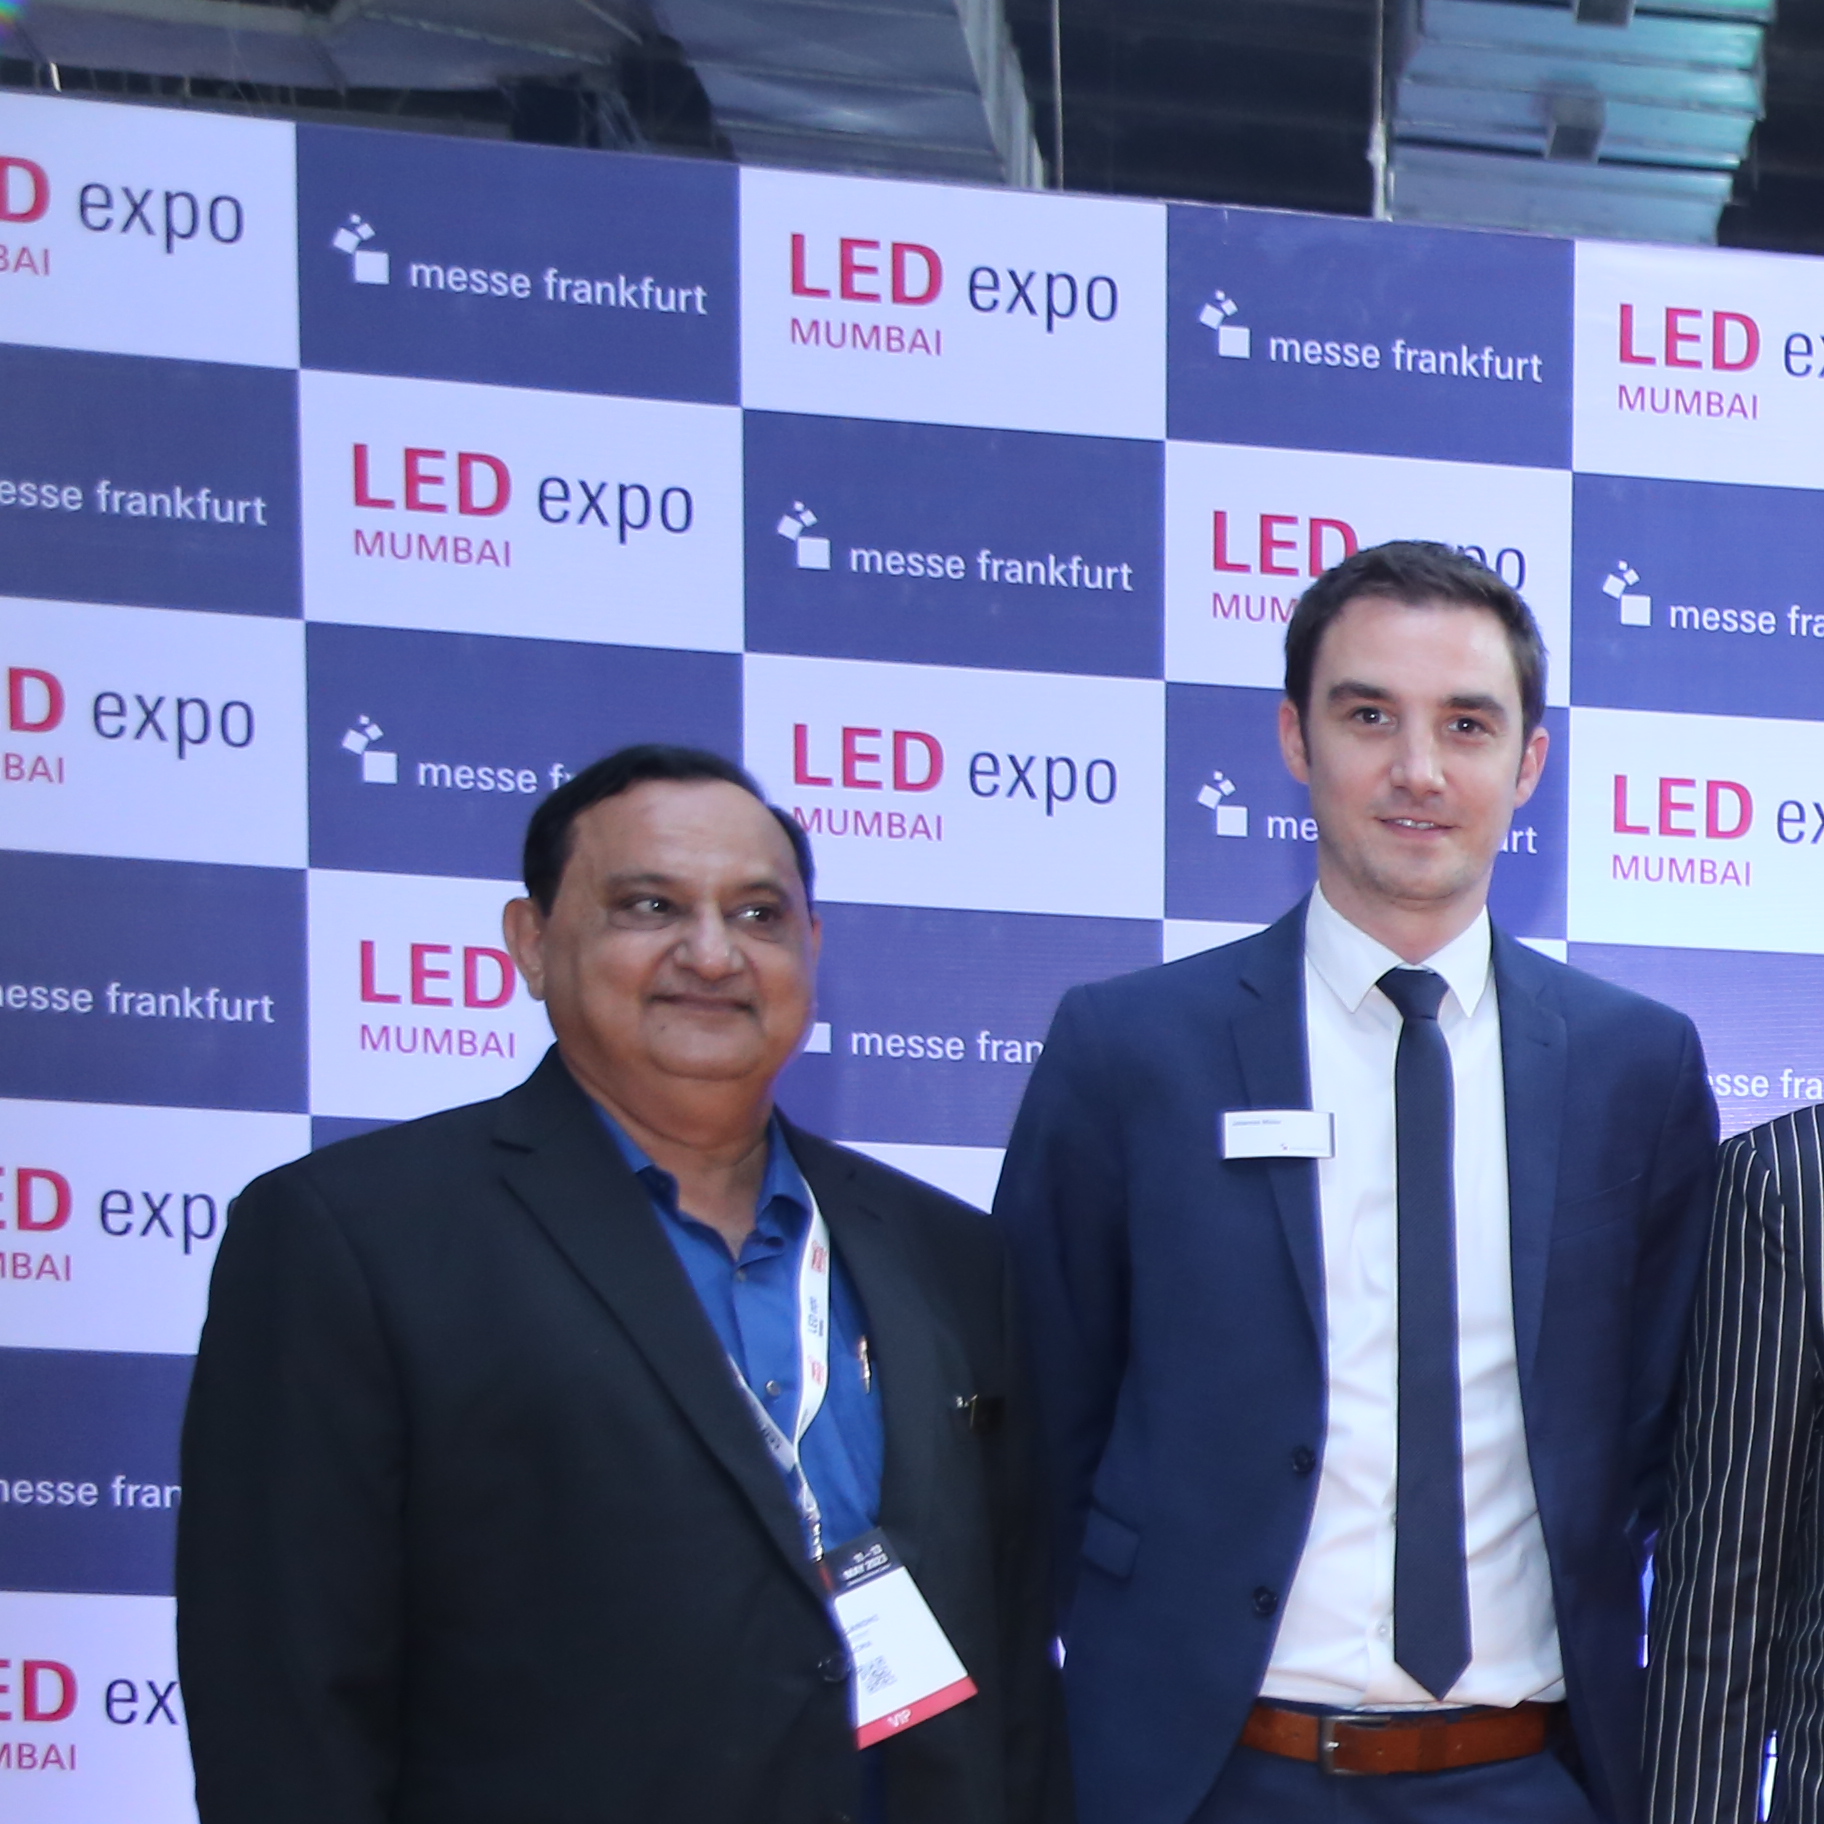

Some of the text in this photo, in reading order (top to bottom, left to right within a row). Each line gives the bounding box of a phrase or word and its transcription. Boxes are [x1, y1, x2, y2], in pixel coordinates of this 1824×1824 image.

[79, 183, 243, 254] expo
[410, 266, 707, 314] messe frankfurt
[791, 233, 1117, 333] LED expo
[791, 317, 941, 356] MUMBAI
[1620, 303, 1760, 371] LED
[1270, 338, 1542, 382] messe frankfurt
[1619, 384, 1757, 419] MUMBAI
[0, 478, 267, 525] esse frankfurt
[353, 443, 693, 545] LED expo
[354, 529, 510, 567] MUMBAI
[1213, 510, 1360, 579] LED
[850, 549, 1132, 591] messe frankfurt
[1213, 583, 1300, 624] MUM
[1670, 606, 1776, 634] messe
[93, 691, 254, 760] expo
[4, 753, 65, 784] BAI
[418, 763, 537, 793] messe
[794, 723, 1116, 816] LED expo
[793, 807, 943, 842] MUMBAI
[1614, 774, 1753, 839] LED
[1613, 854, 1750, 886] MUMBAI
[360, 940, 516, 1009] LED
[0, 982, 274, 1023] esse frankfurt
[360, 1024, 514, 1058] MUMBAI
[852, 1033, 964, 1060] messe
[1708, 1072, 1770, 1098] sse
[100, 1188, 218, 1255] exp
[105, 1678, 180, 1727] ex
[886, 1708, 912, 1728] VIP
